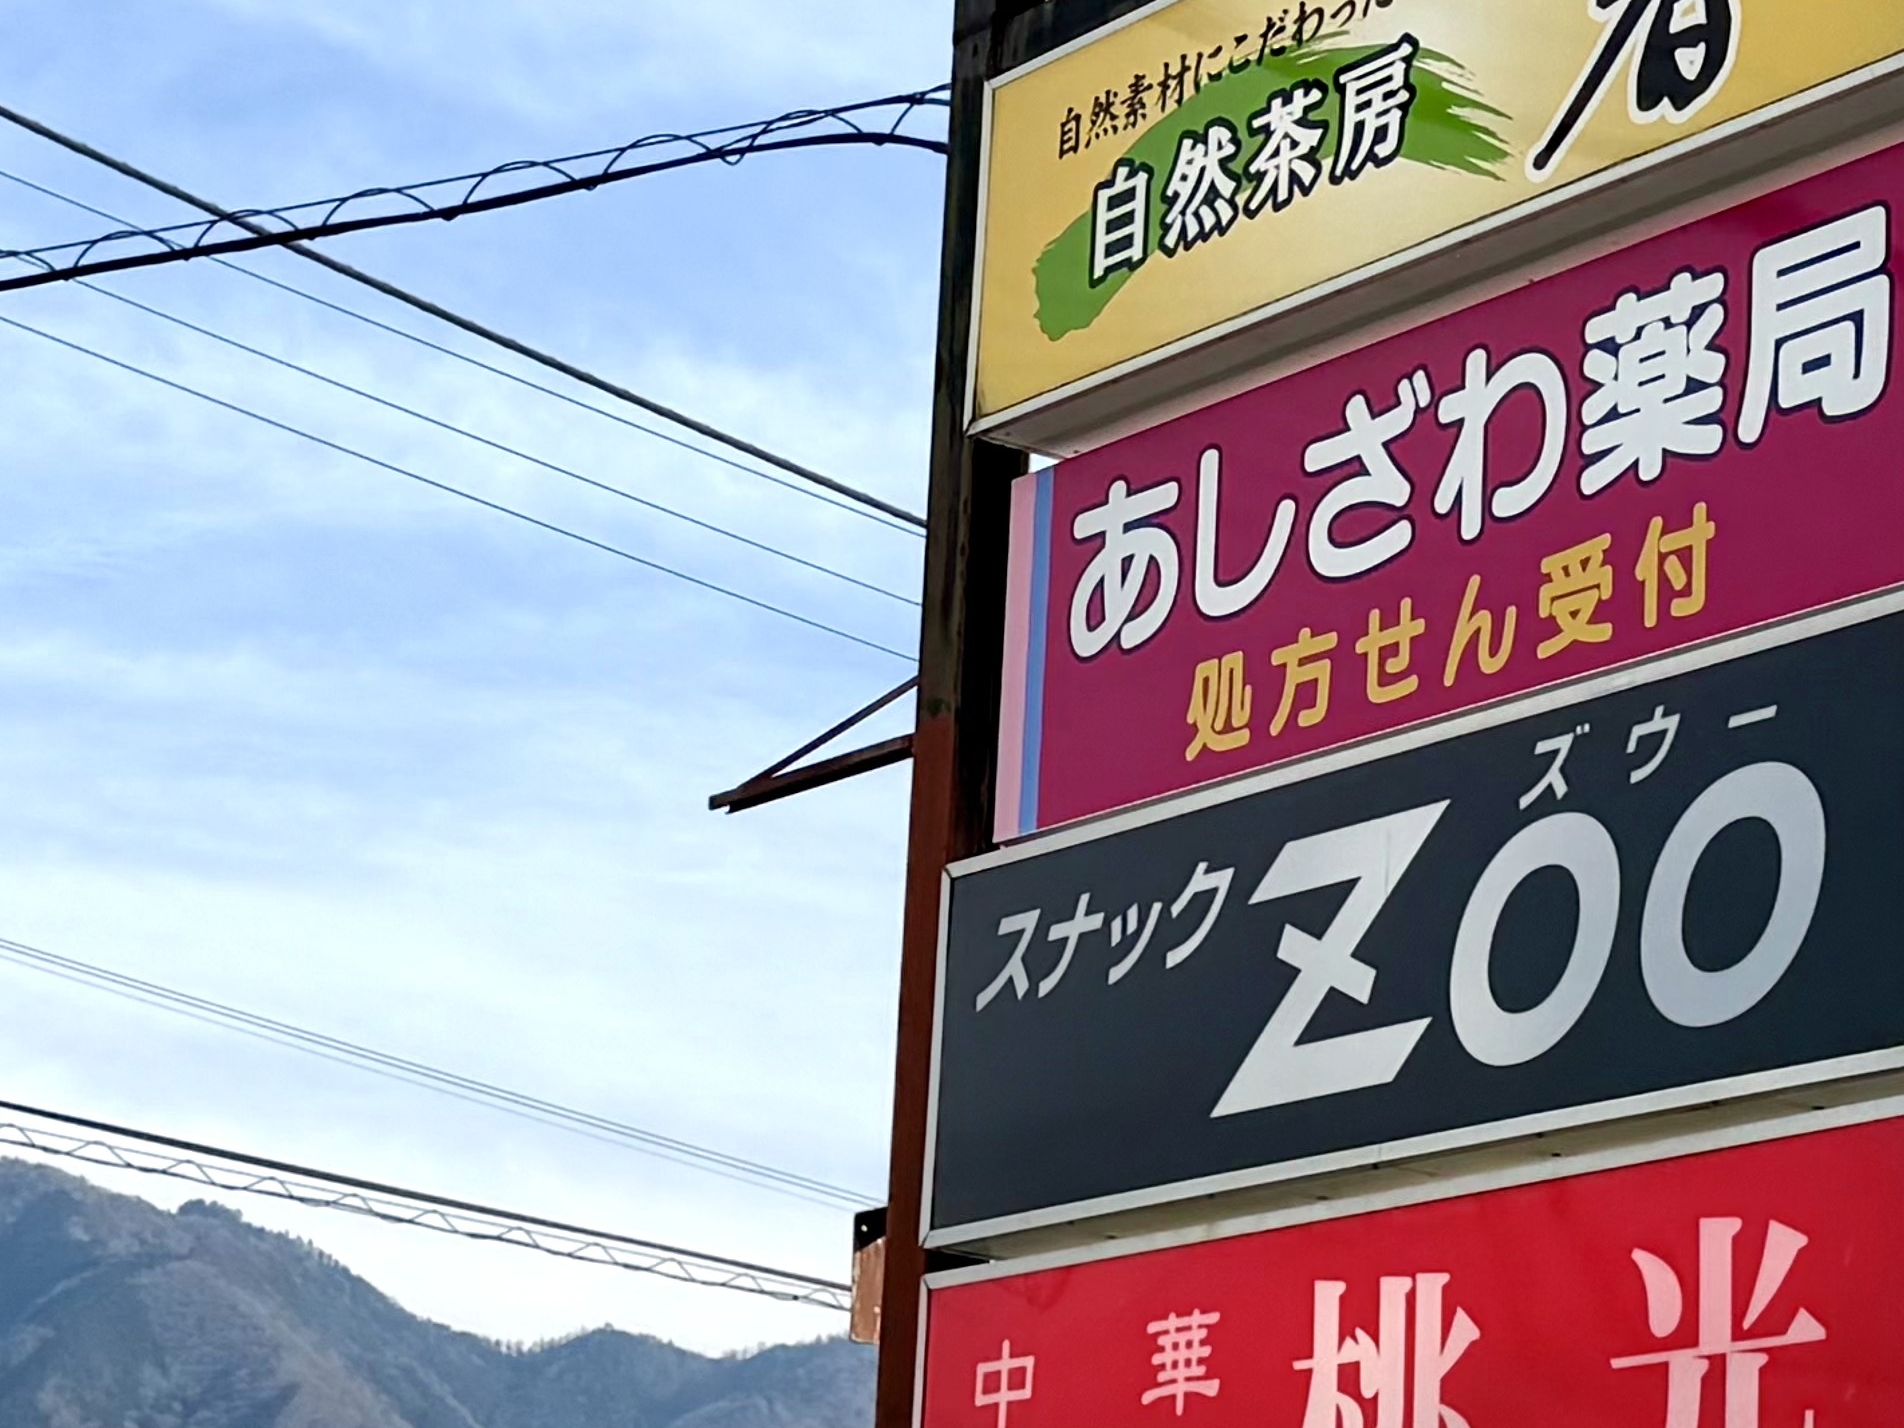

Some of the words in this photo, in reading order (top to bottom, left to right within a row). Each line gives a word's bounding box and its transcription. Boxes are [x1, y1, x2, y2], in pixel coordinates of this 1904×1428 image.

[1089, 35, 1418, 283] 自然茶房
[1070, 206, 1890, 660] あしざわ薬局
[1184, 502, 1715, 763] 処方せん受付
[1517, 702, 1779, 811] ズウー
[974, 860, 1236, 1012] スナック
[1209, 760, 1828, 1118] ZOO
